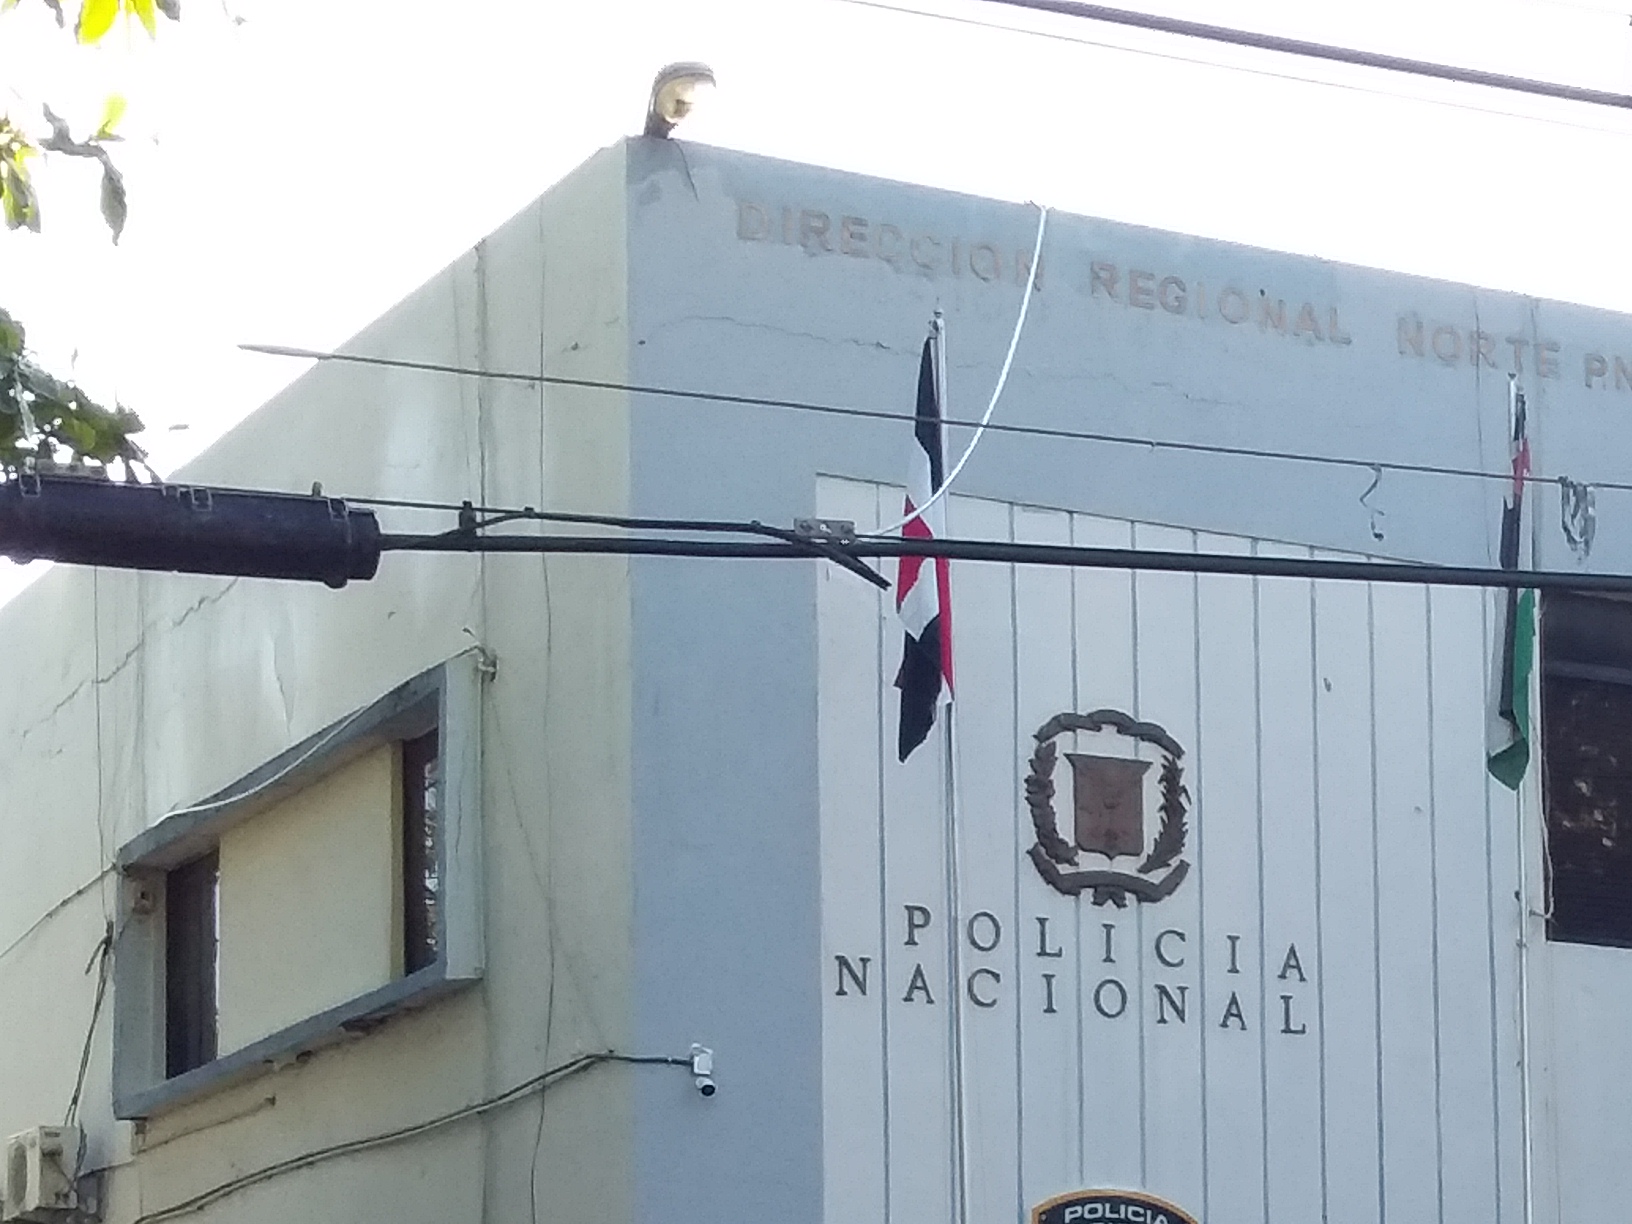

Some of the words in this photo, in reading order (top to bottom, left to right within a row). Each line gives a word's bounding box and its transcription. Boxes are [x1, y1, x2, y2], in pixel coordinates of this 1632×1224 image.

[1090, 260, 1352, 346] REGIONAL
[1396, 311, 1562, 379] NORTE
[903, 904, 1308, 983] POLICIA
[834, 954, 1306, 1036] NACIONAL
